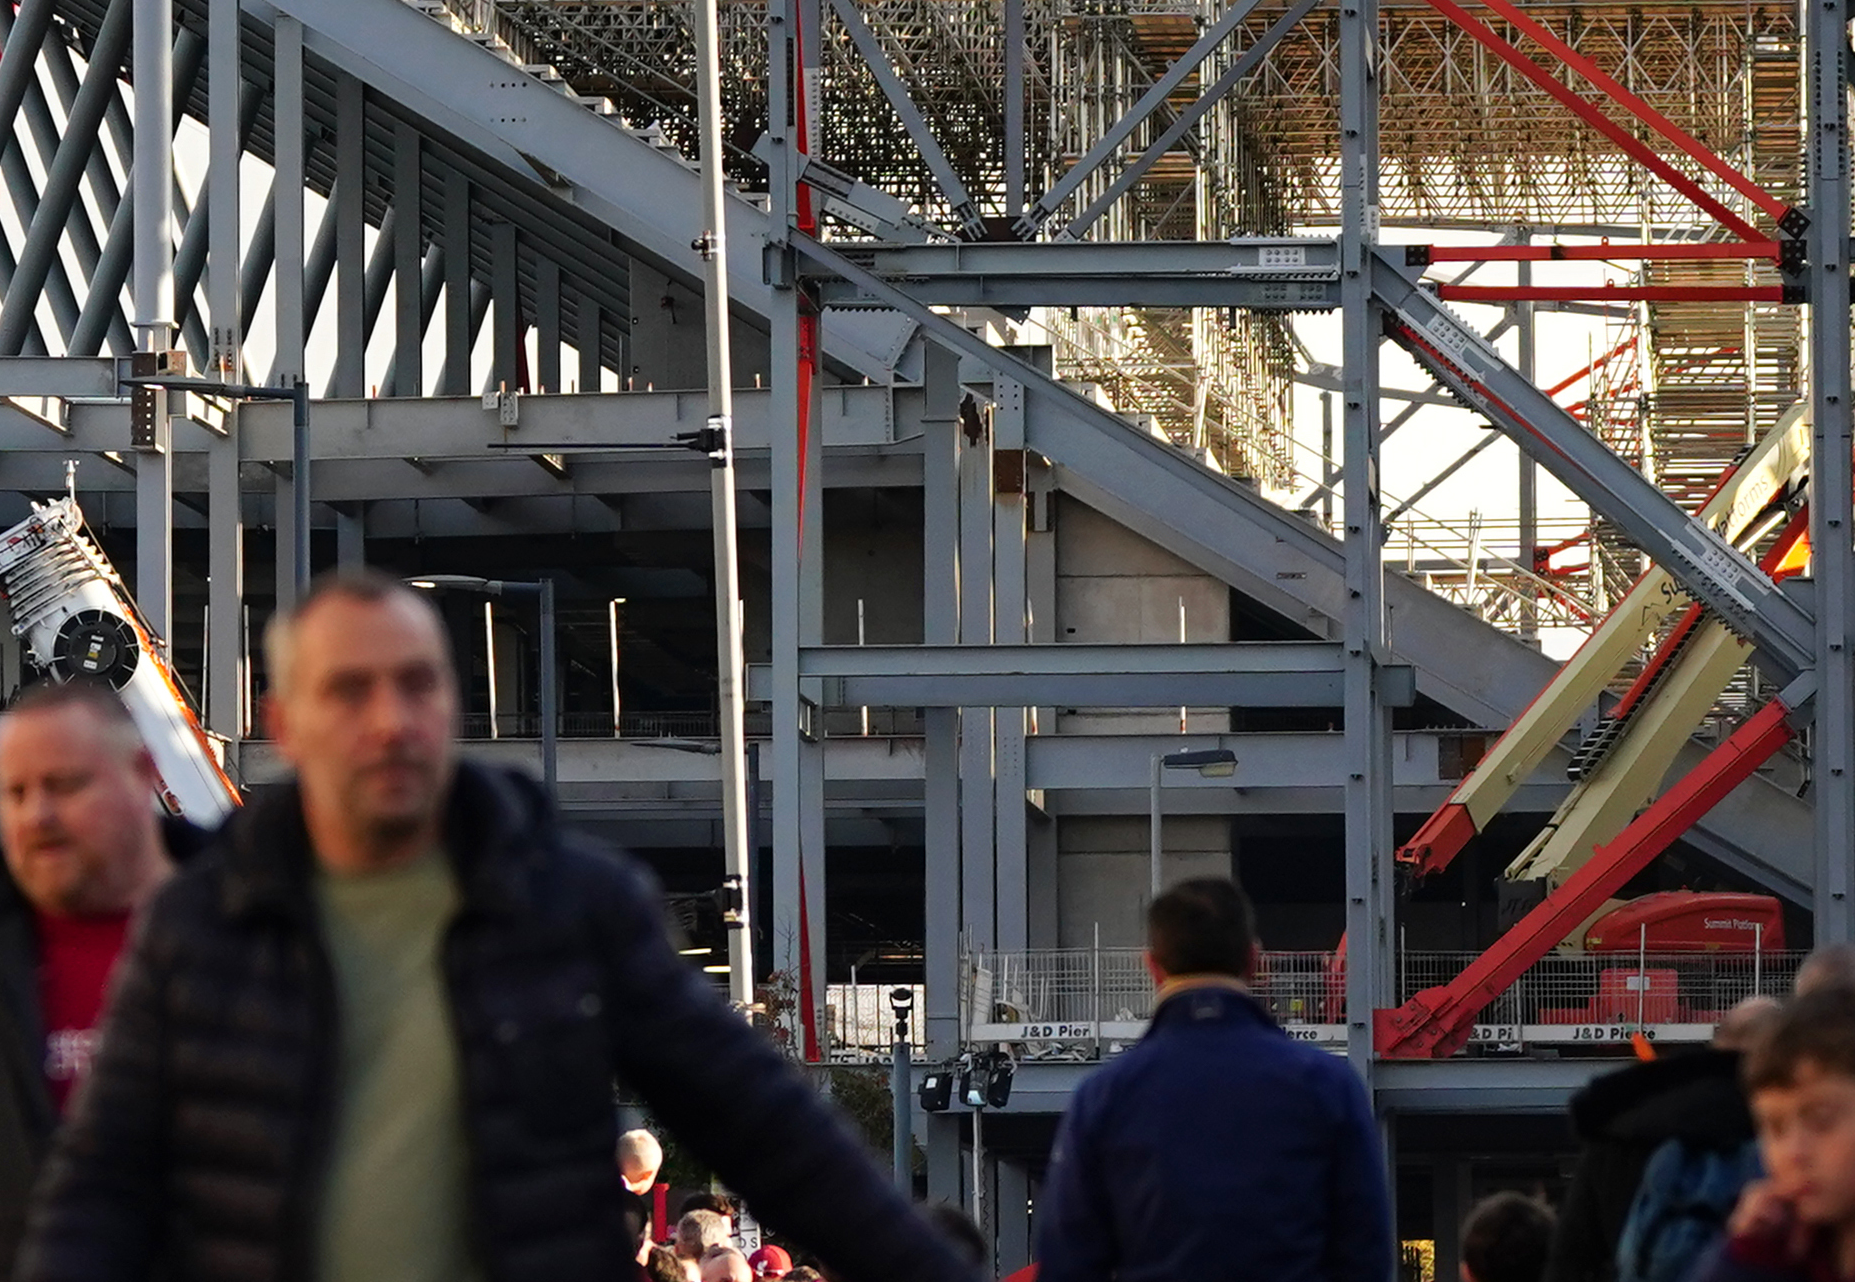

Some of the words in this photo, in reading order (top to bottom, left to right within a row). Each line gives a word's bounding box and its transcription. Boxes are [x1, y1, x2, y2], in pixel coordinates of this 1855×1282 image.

[1703, 917, 1732, 929] Summit
[1732, 918, 1765, 931] Platfors
[1021, 1025, 1053, 1038] J&D
[1573, 1027, 1605, 1040] J&D
